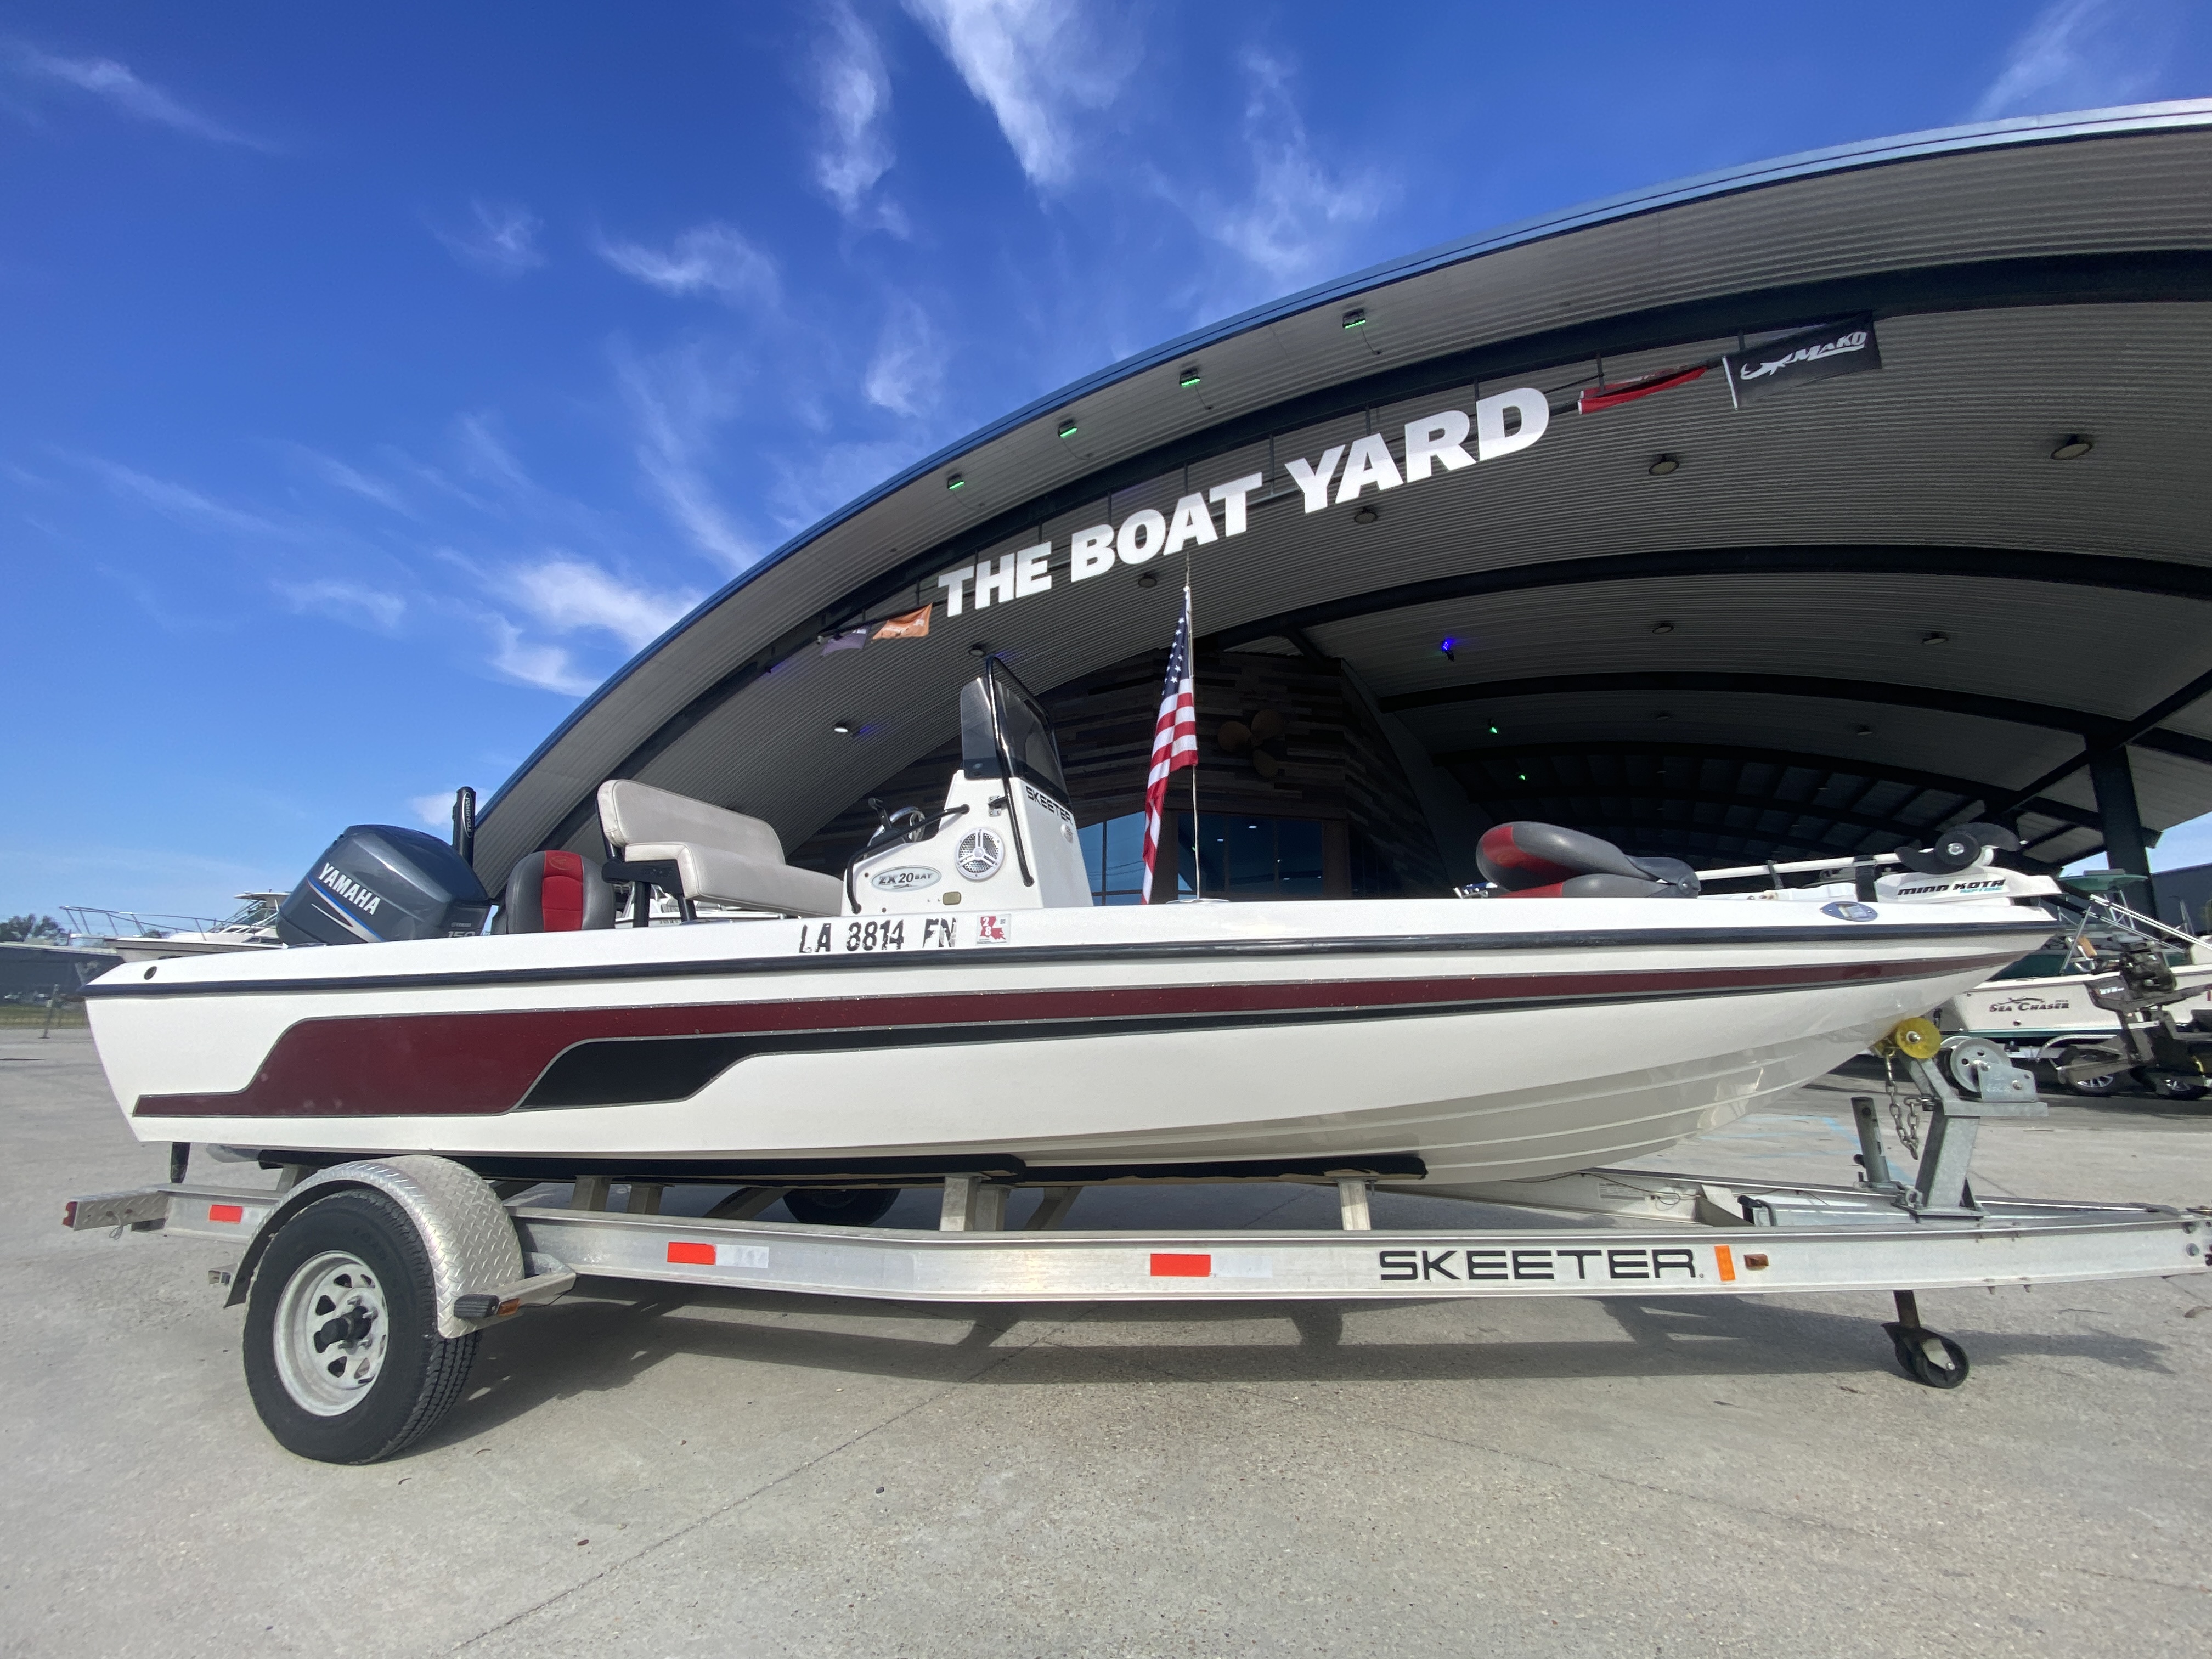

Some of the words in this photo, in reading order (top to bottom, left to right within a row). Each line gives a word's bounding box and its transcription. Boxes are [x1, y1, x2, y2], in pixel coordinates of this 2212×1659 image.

[1785, 331, 1866, 362] MAKO
[938, 541, 1052, 617] THE
[1070, 472, 1263, 583] BOAT
[1284, 387, 1549, 514] YARD
[1026, 786, 1073, 826] SKEETER
[318, 862, 381, 915] YAMAHA
[898, 873, 914, 883] 20
[1953, 879, 2006, 890] KOTA
[799, 923, 832, 953] LA
[846, 919, 904, 951] 8814
[922, 917, 957, 948] FN
[1379, 1249, 1696, 1280] SKEETER
